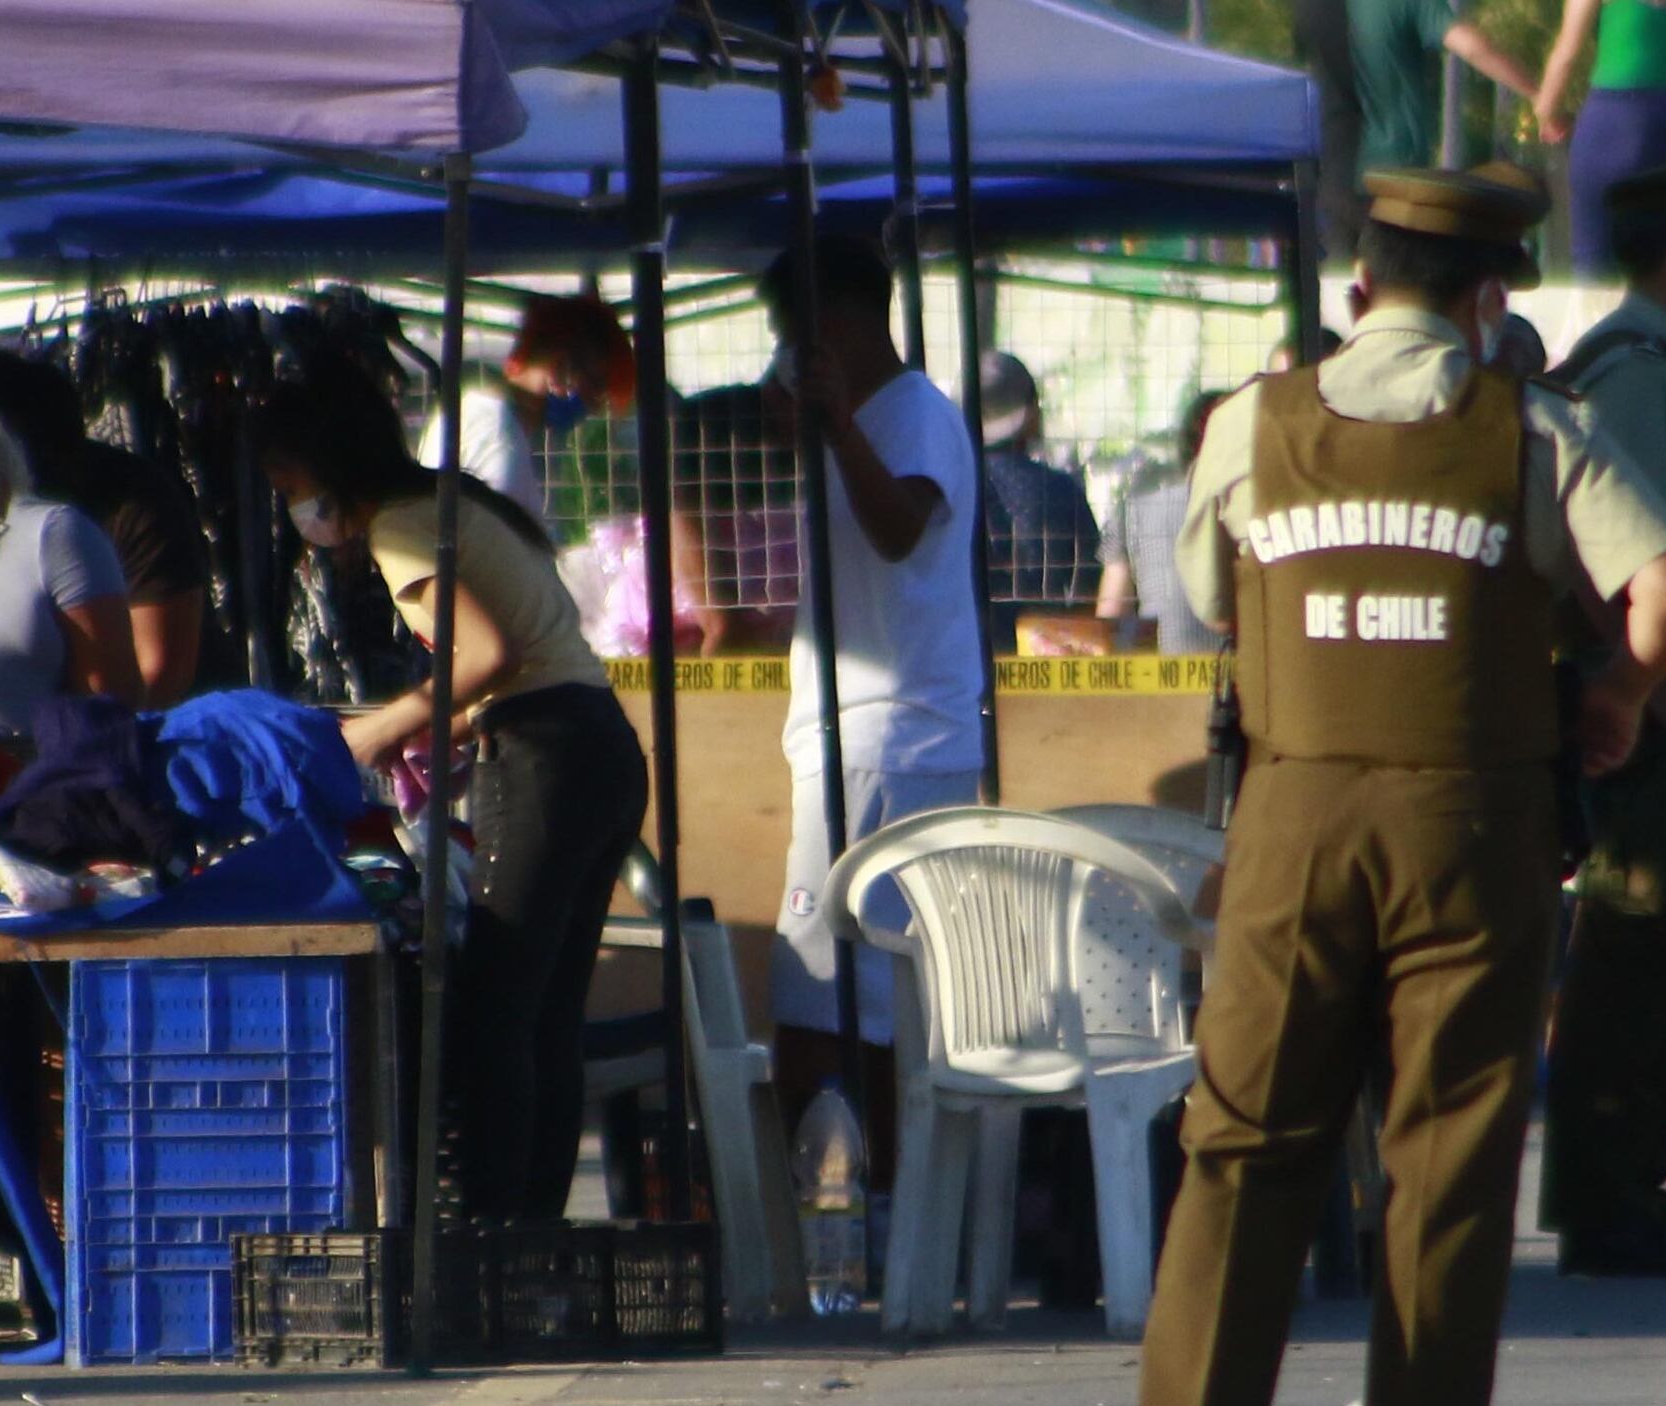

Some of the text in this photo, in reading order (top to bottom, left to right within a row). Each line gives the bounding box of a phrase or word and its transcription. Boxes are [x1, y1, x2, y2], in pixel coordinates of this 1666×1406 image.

[1248, 501, 1508, 567] CARABINEROS
[1305, 594, 1447, 641] DE CHILE
[723, 663, 742, 691] DE
[751, 662, 789, 690] CHIL
[1060, 661, 1081, 690] DE
[1088, 661, 1133, 689] CHILE
[1158, 660, 1180, 689] NO
